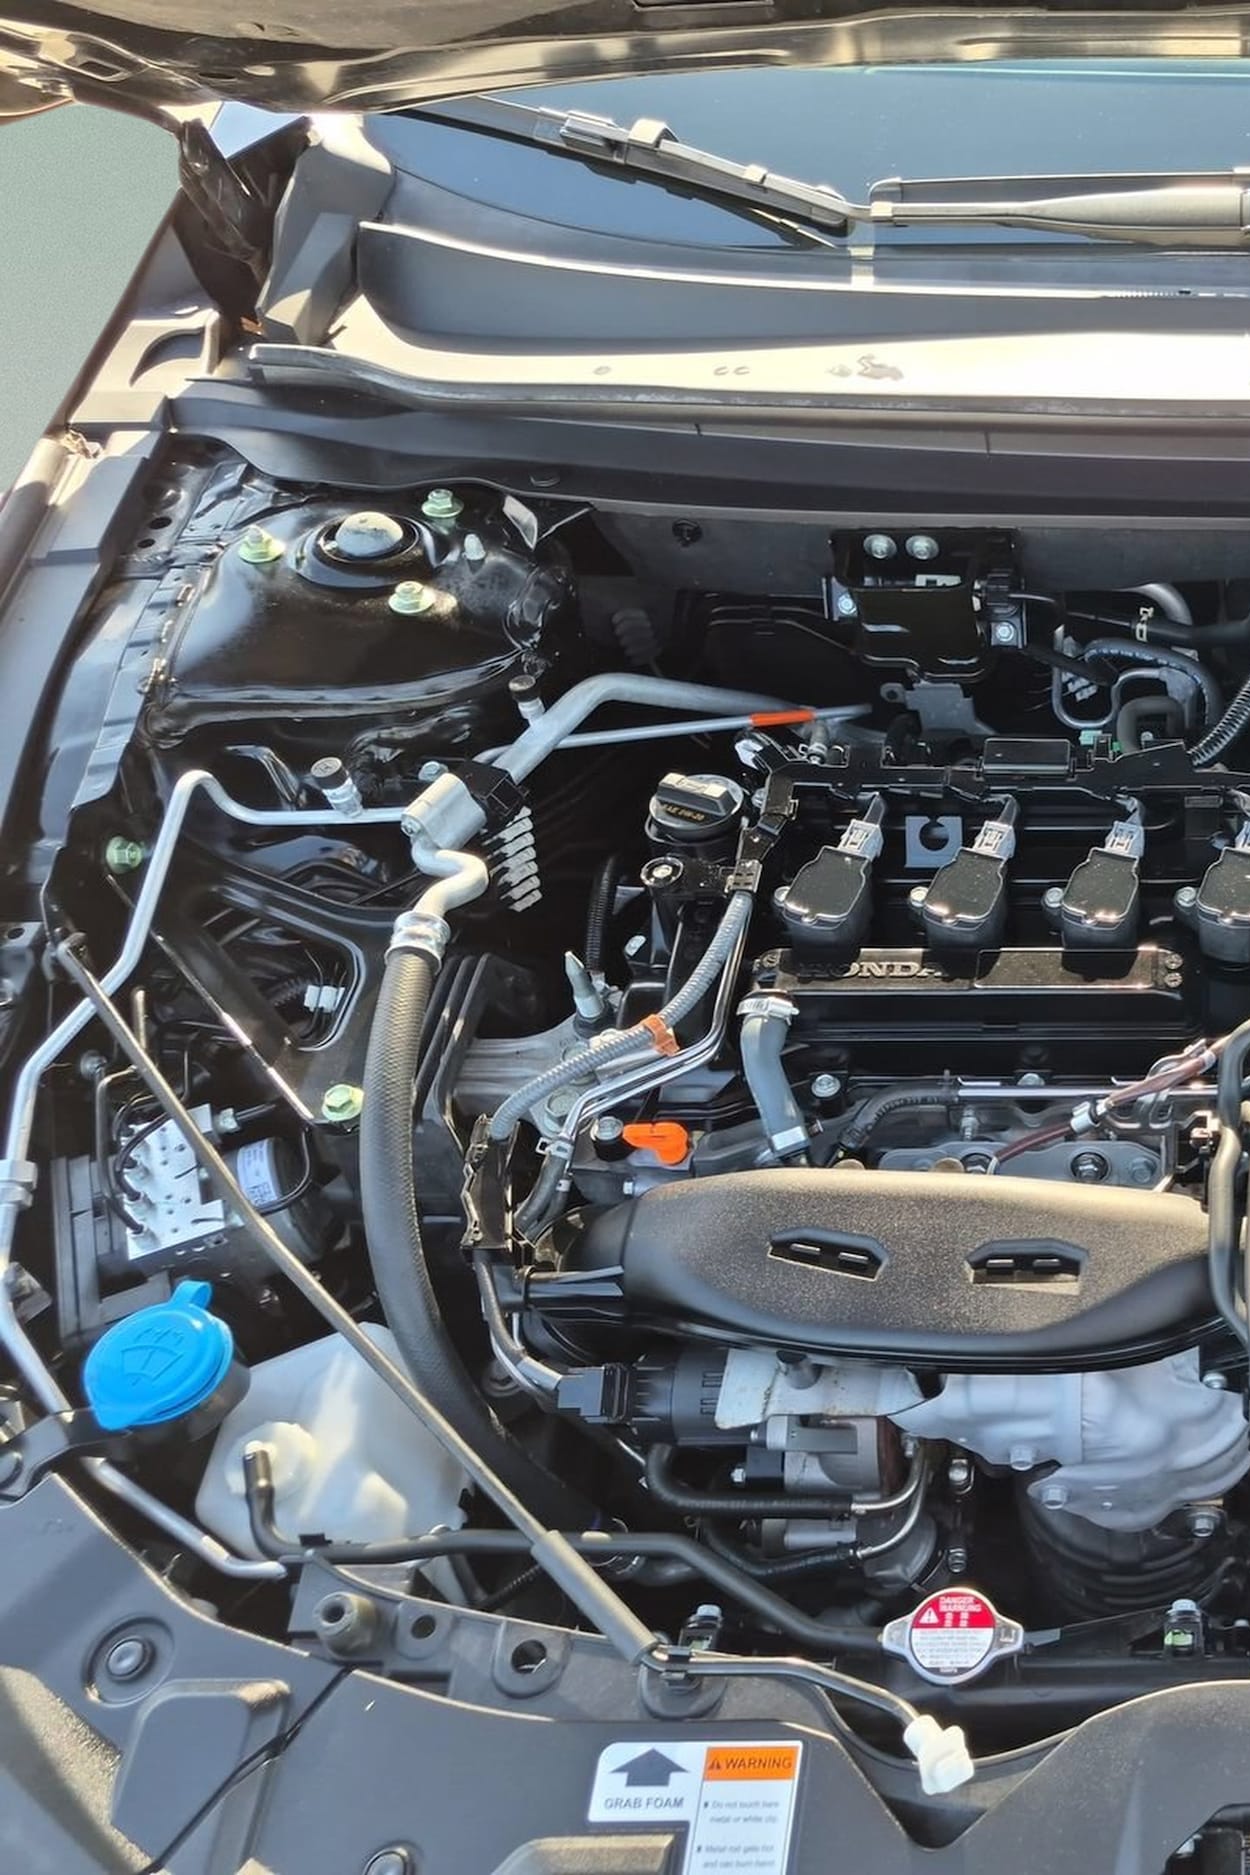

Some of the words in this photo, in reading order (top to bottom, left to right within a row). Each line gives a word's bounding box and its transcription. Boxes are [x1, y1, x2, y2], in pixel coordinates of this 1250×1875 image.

[939, 1597, 974, 1605] DANGER
[939, 1604, 982, 1612] WARNING
[725, 1757, 793, 1770] WARNING
[604, 1797, 642, 1810] GRAB
[645, 1797, 684, 1809] FOAM
